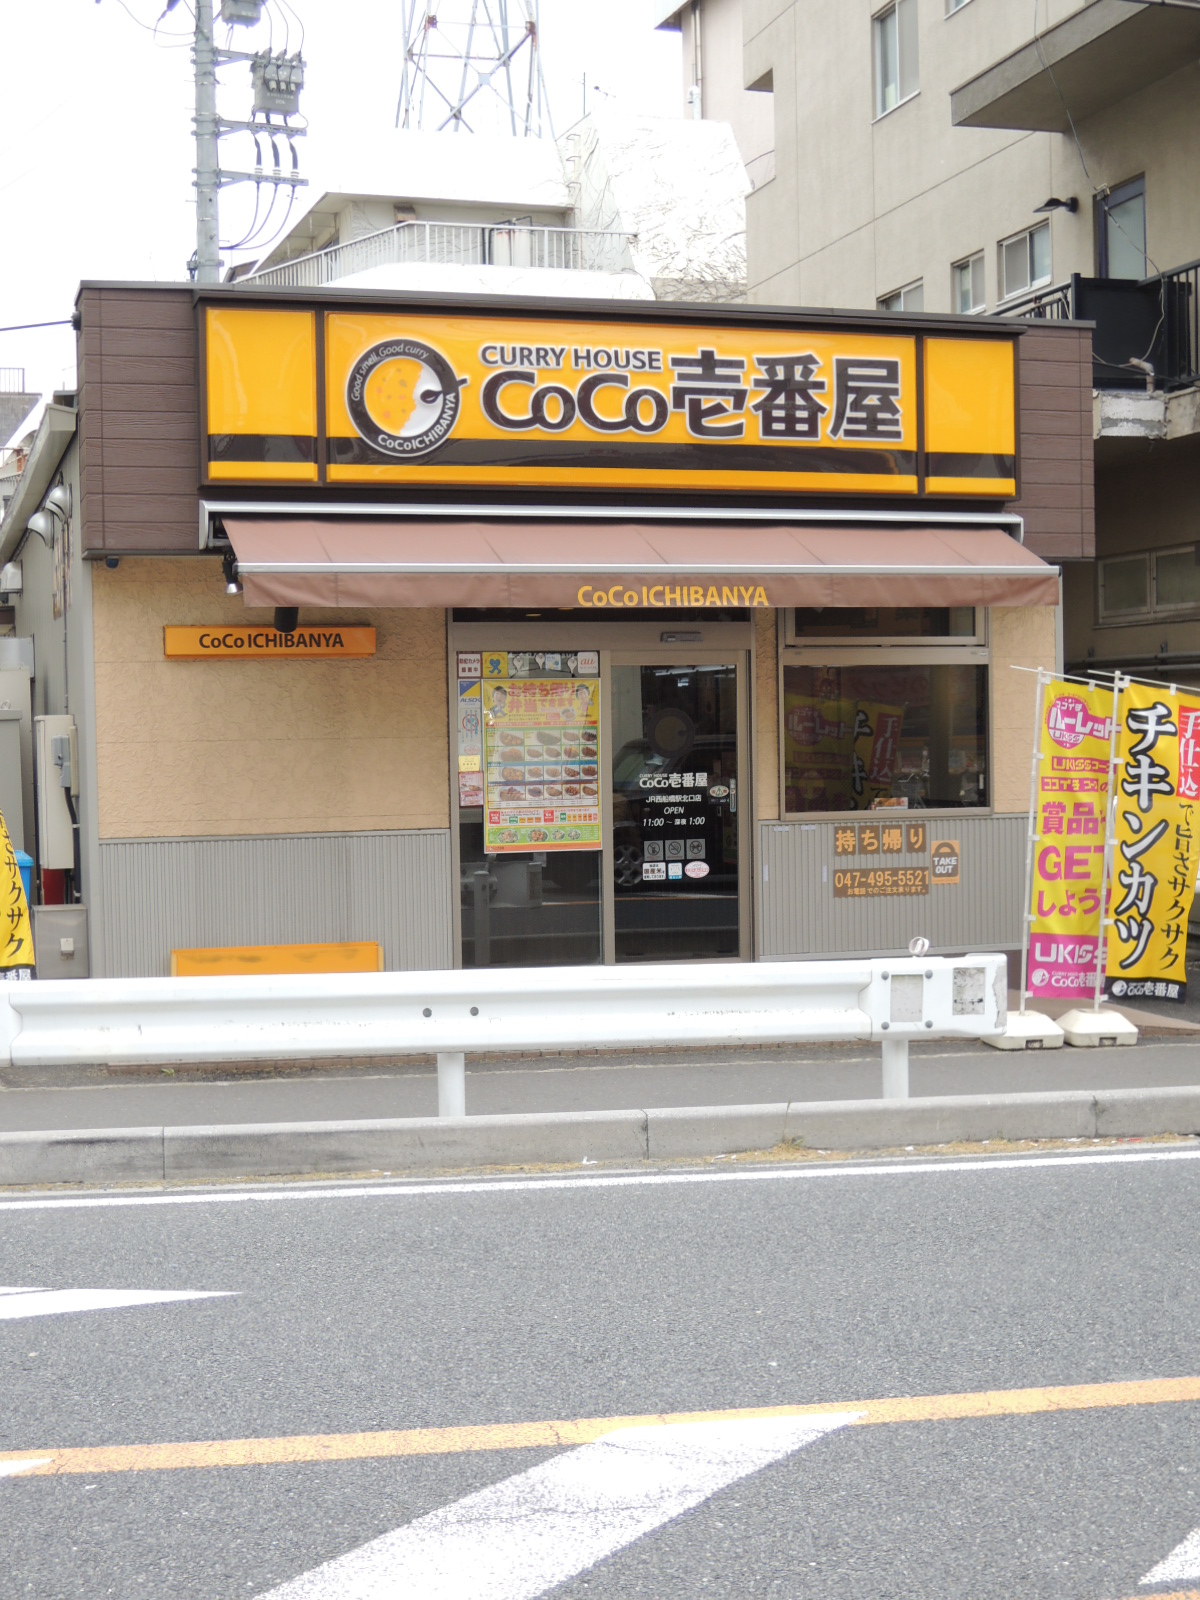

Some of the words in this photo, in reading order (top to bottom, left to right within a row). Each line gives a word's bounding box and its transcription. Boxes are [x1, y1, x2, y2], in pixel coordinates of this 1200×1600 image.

[481, 346, 565, 367] CURRY
[574, 349, 662, 370] HOUSE
[351, 375, 363, 402] Good
[379, 344, 404, 357] Good
[405, 345, 430, 359] curry
[663, 806, 685, 815] OPEN
[643, 817, 665, 827] 11:00
[689, 816, 706, 826] 1:00
[835, 827, 924, 853] 持ち帰り
[1114, 703, 1177, 970] チキンカツ
[933, 857, 958, 866] TAKE
[935, 865, 954, 874] OUT
[835, 870, 929, 888] 047-495-5521
